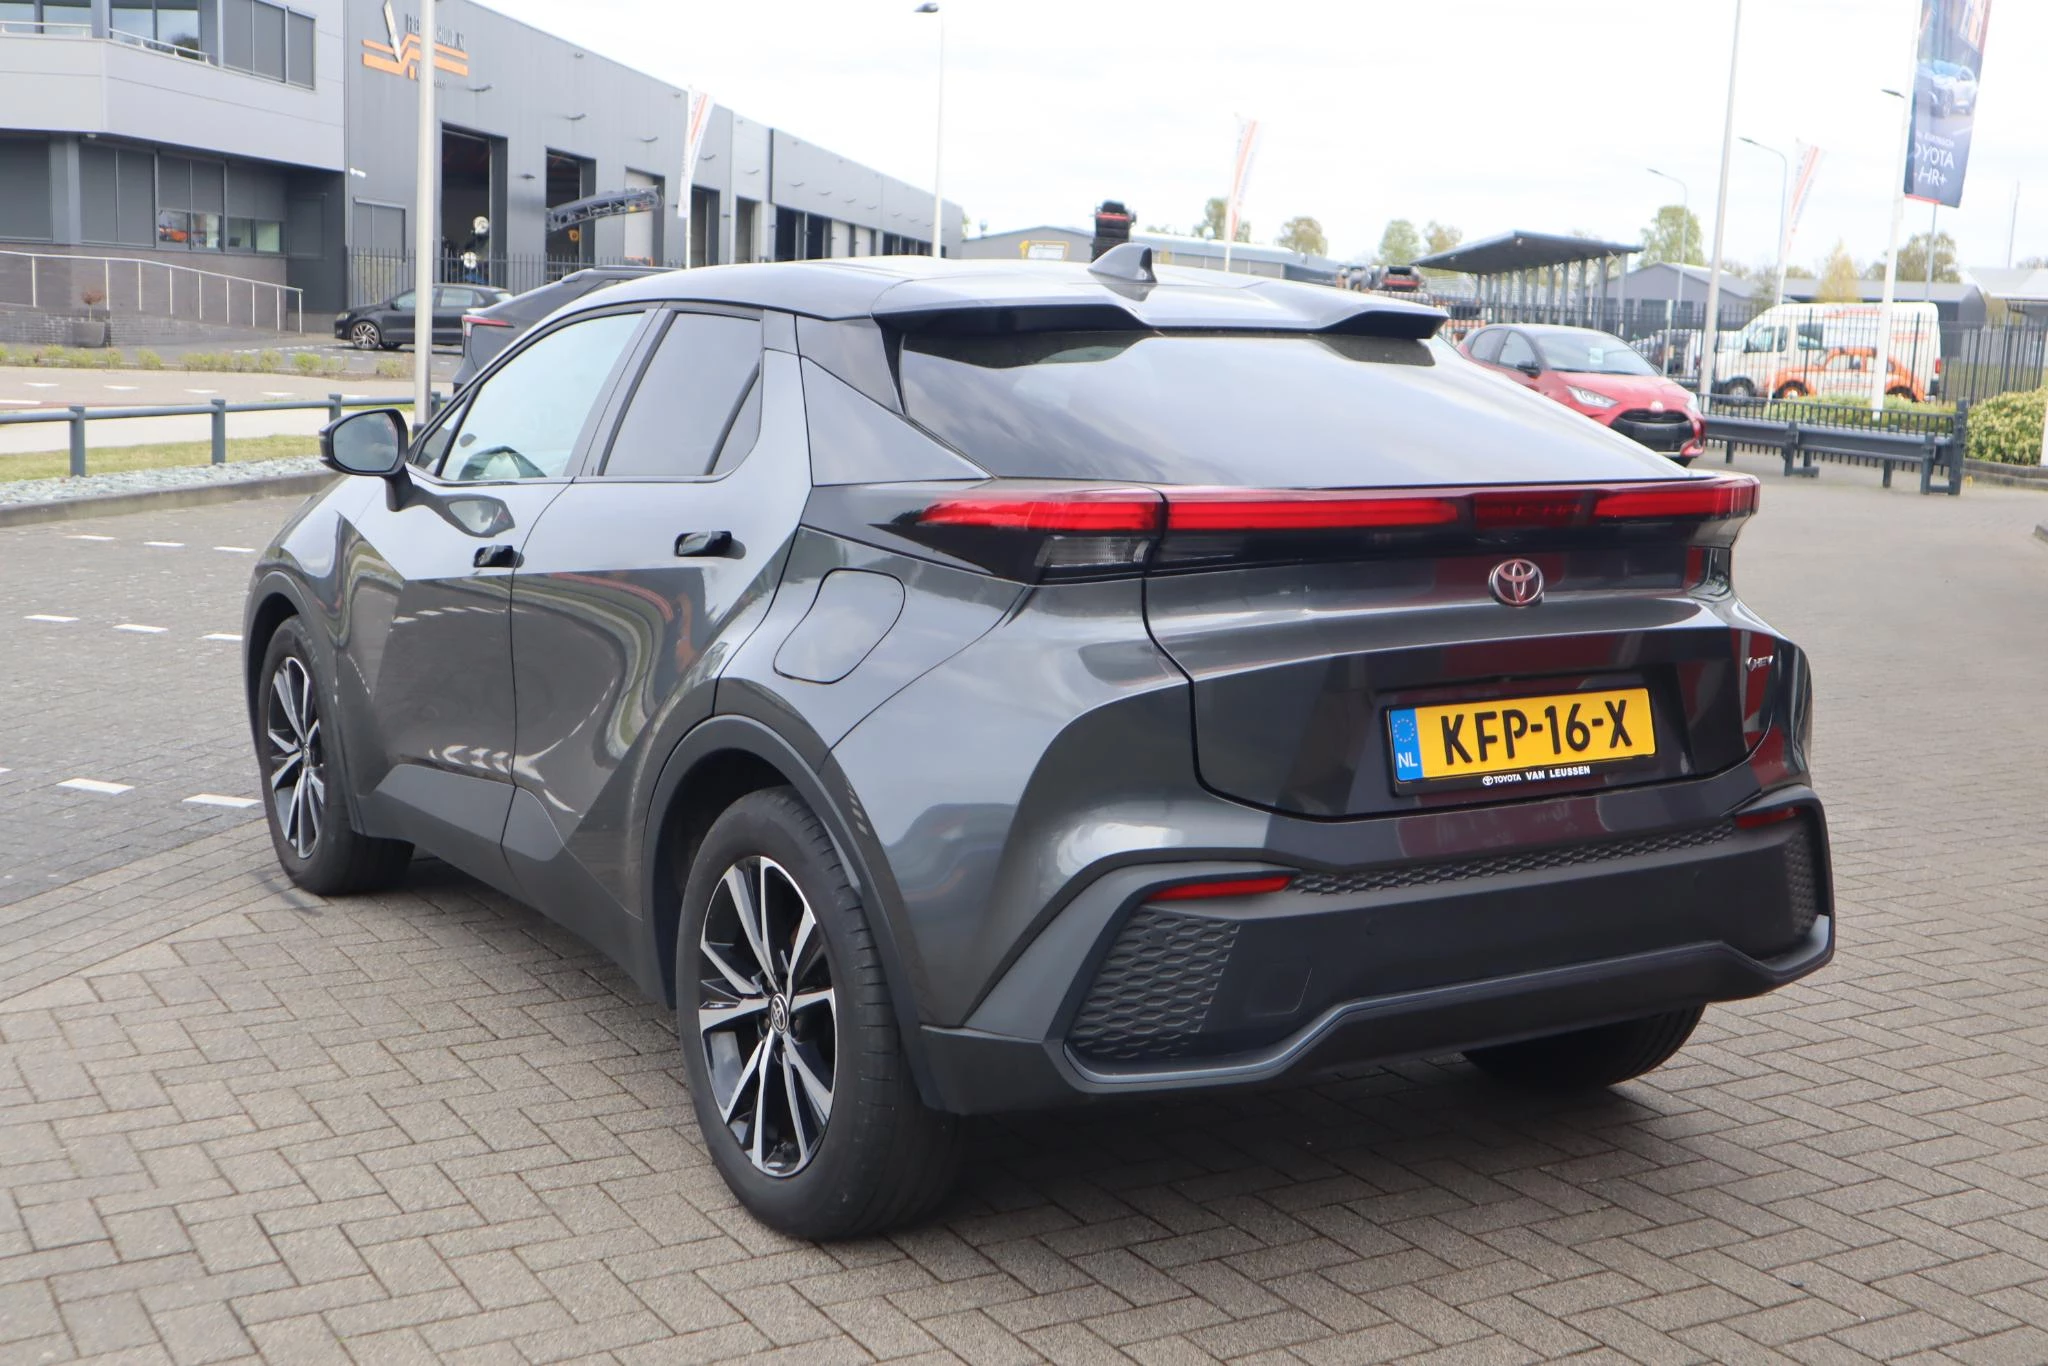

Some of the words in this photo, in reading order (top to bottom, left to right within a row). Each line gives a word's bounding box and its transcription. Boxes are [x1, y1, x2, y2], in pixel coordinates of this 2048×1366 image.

[1914, 141, 1954, 169] OYOTA
[1440, 699, 1633, 766] KFP-16-X
[1397, 752, 1418, 768] NL
[1493, 773, 1522, 784] TOYOTA
[1525, 769, 1546, 781] VAN
[1550, 765, 1591, 778] LEUSSEN
